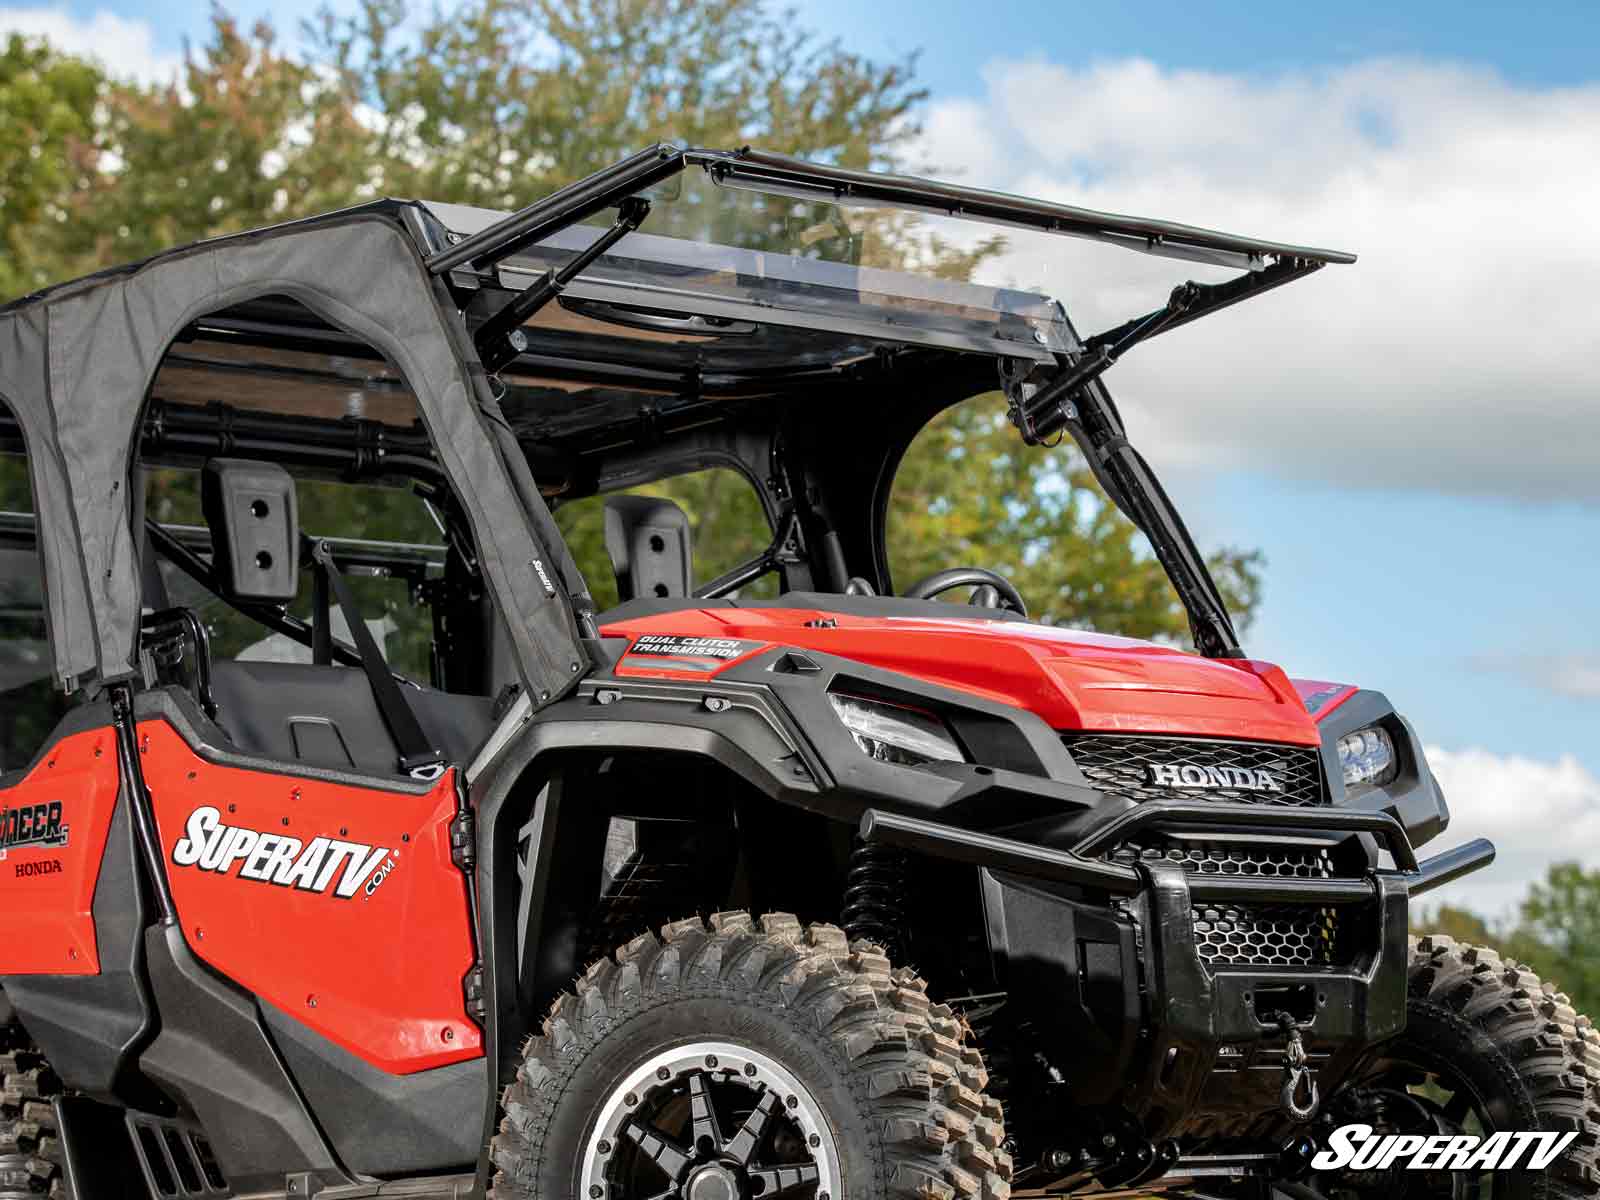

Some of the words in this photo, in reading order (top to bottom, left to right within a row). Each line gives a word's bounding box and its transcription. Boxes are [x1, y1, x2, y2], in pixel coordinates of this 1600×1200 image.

[633, 643, 743, 657] TRANSMISSION
[639, 635, 677, 645] DUAL
[681, 637, 741, 648] CLUTCH
[1148, 763, 1281, 792] HONDA
[173, 805, 391, 899] SUPERATV
[15, 860, 63, 878] HONDA
